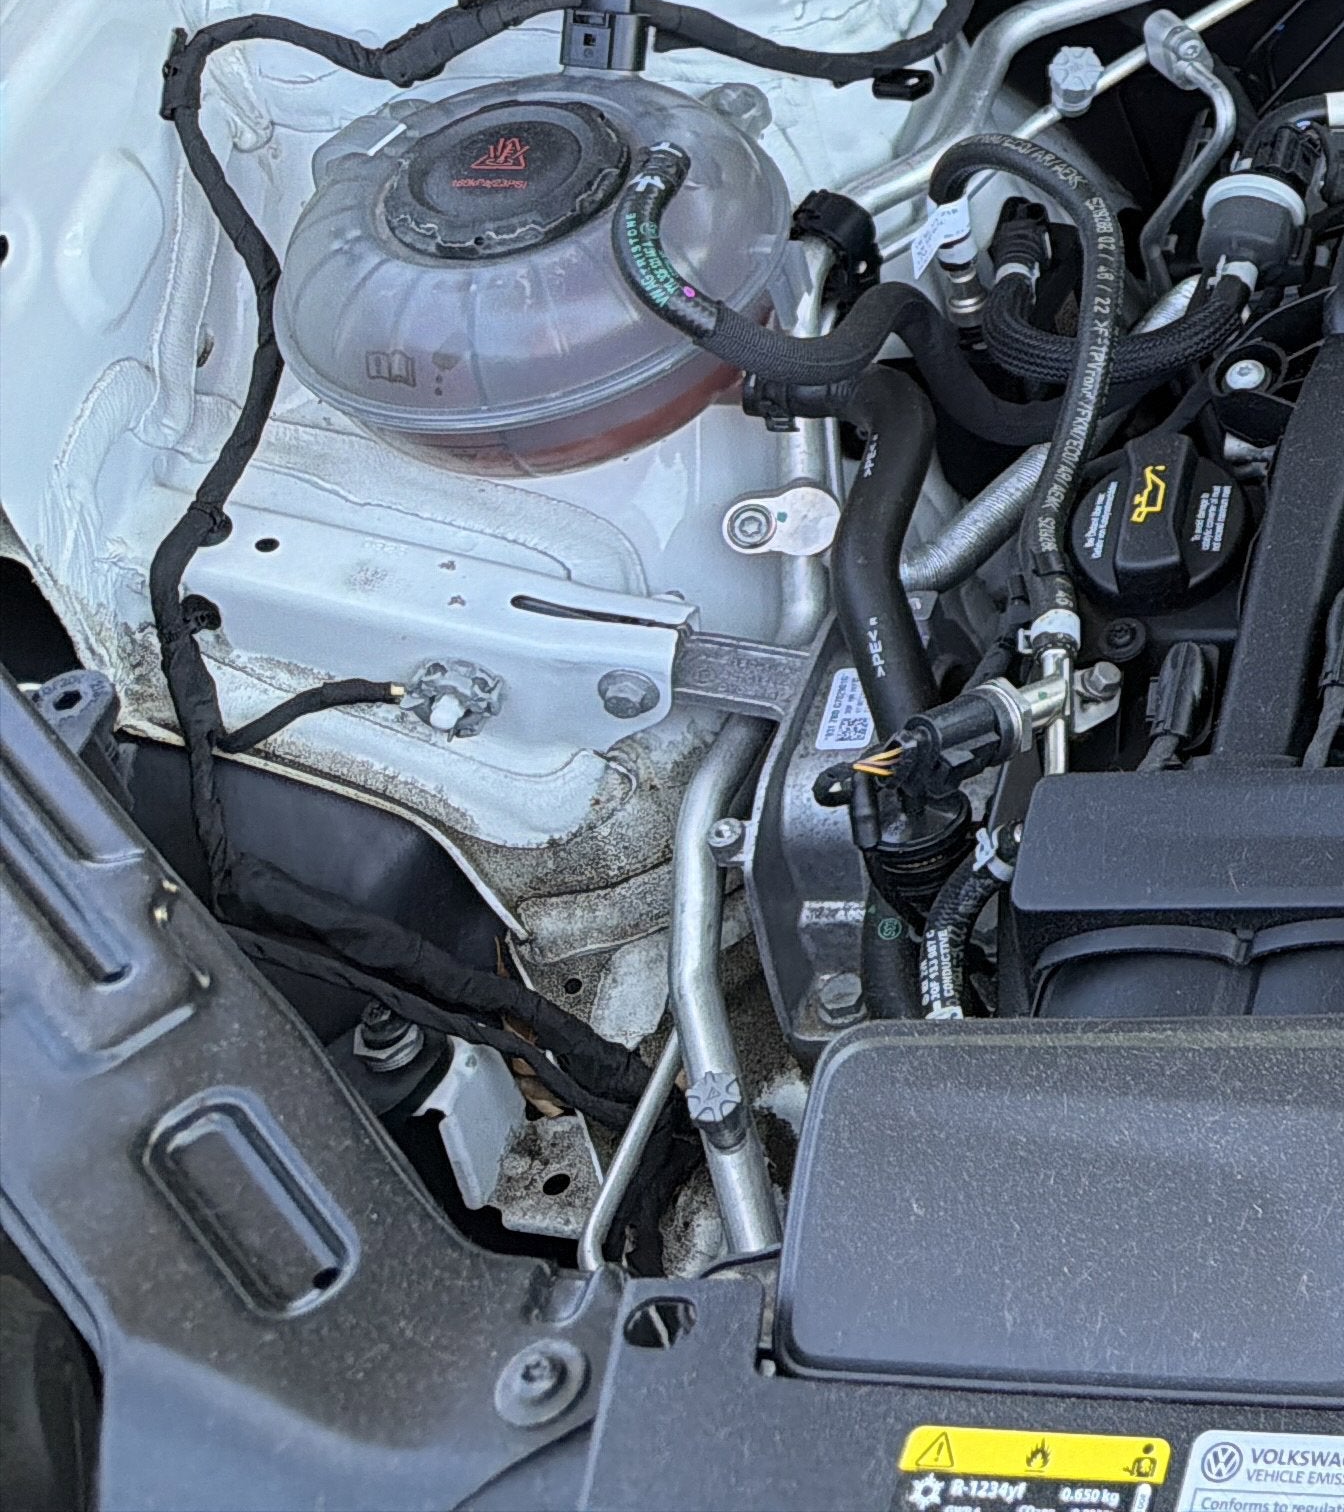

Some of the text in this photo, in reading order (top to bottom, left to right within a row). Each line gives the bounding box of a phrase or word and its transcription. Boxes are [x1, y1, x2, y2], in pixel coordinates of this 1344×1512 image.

[937, 929, 954, 997] CONDUCTIVE
[1246, 1468, 1305, 1485] VEHICLE
[948, 1478, 1027, 1504] R-1234yf
[1101, 1487, 1120, 1509] kg
[1201, 1496, 1269, 1511] Conforms
[1273, 1500, 1289, 1512] to
